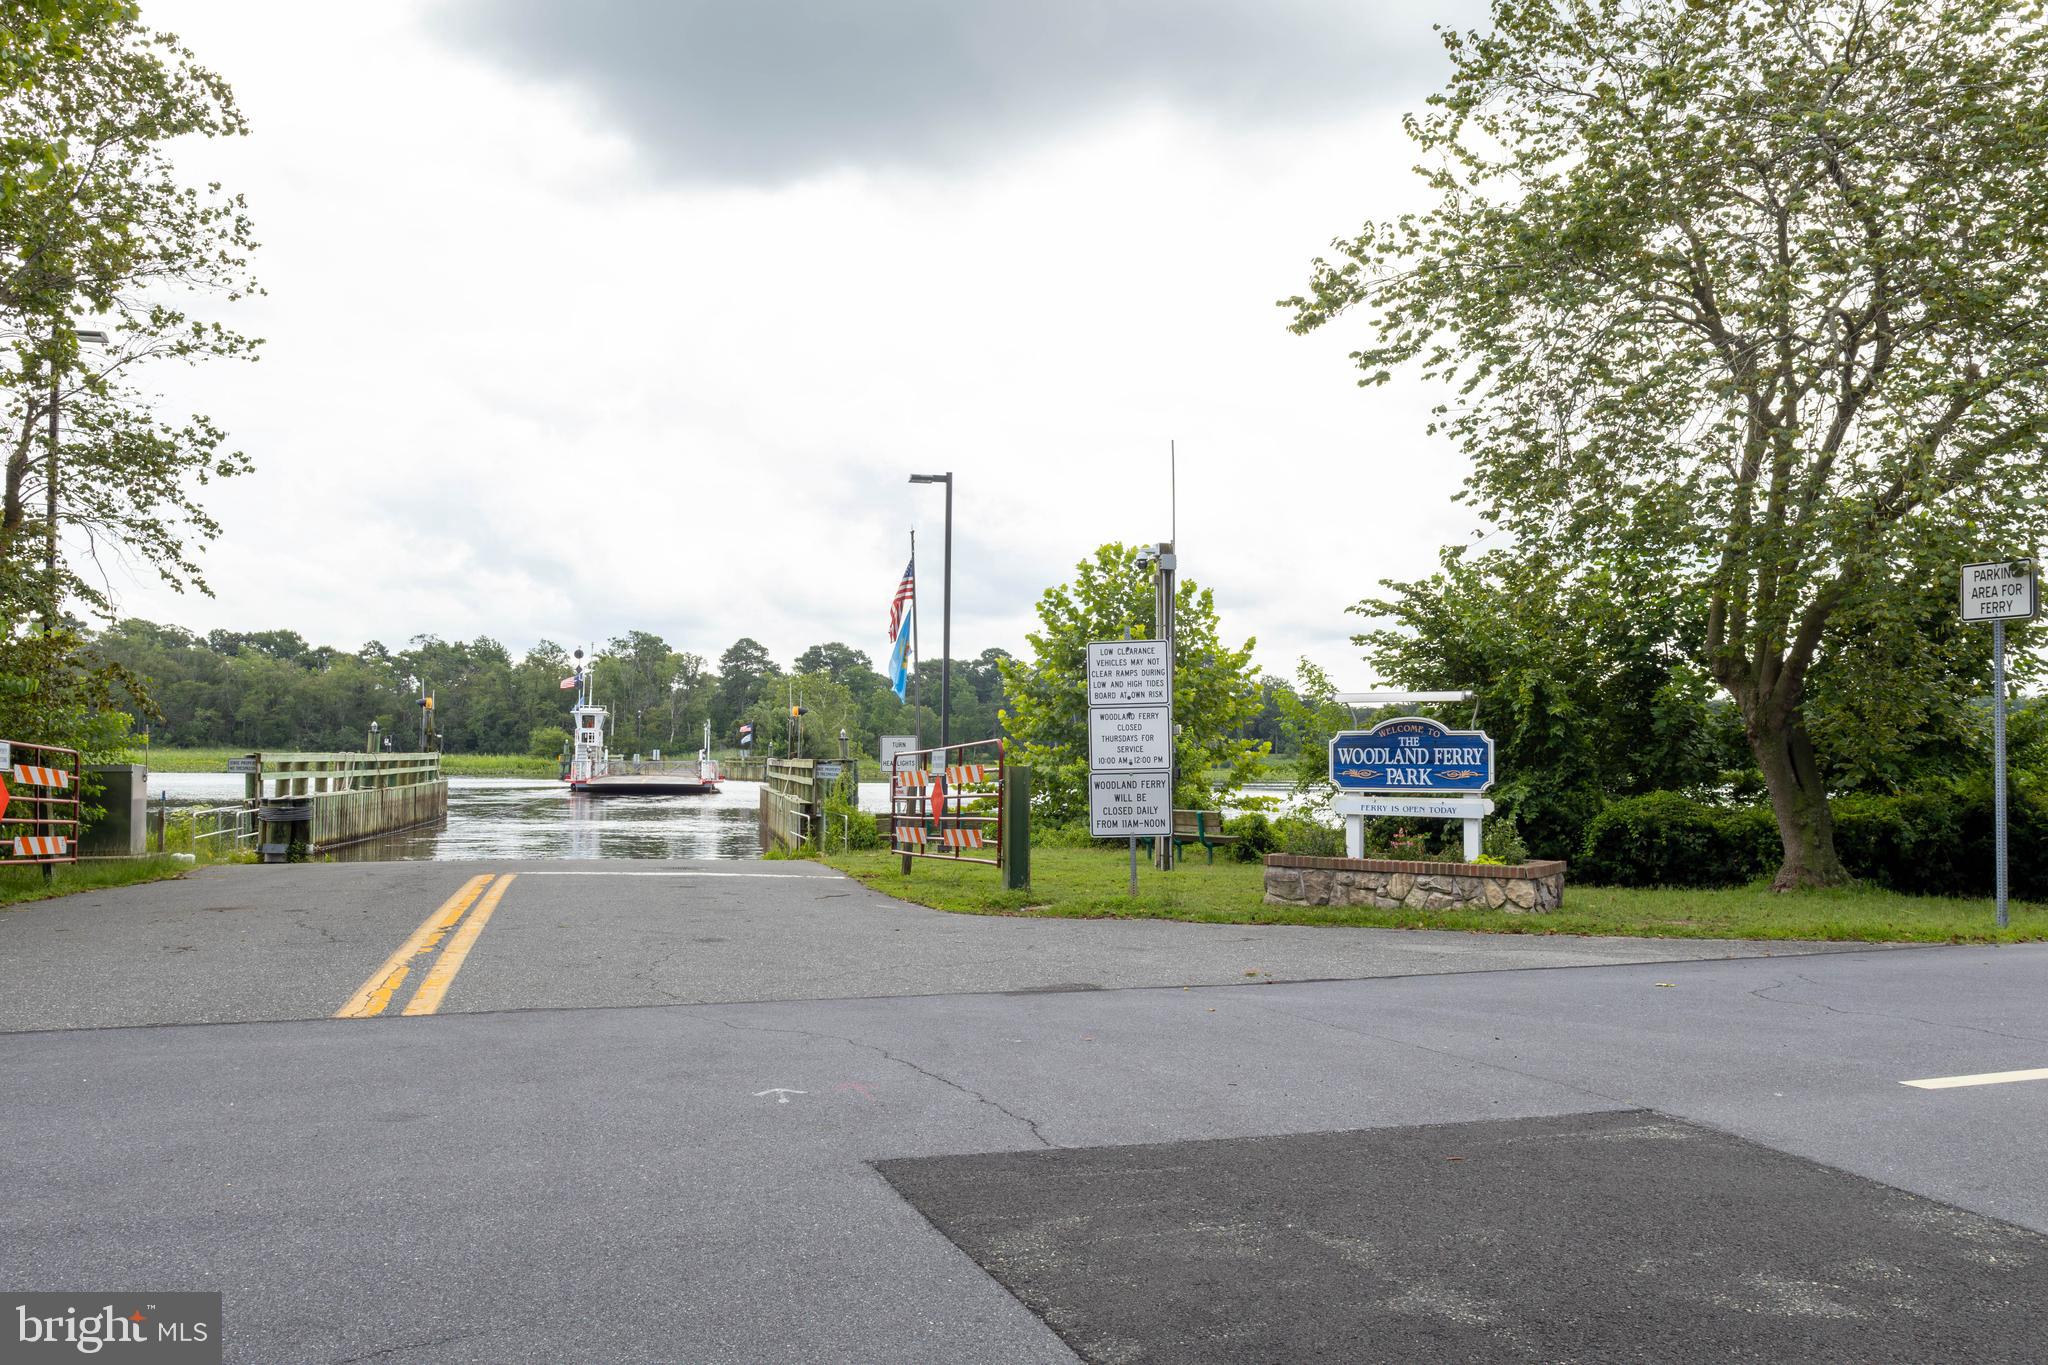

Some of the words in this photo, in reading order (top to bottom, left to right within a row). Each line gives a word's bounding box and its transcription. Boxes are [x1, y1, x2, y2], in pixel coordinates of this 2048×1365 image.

[1974, 567, 2017, 582] PARKIN
[1971, 585, 1999, 600] AREA
[2001, 583, 2023, 597] FOR
[1980, 600, 2013, 615] FERRY
[1100, 648, 1114, 656] LOW
[1096, 659, 1127, 667] VEHICLES
[1130, 658, 1144, 666] MAY
[1147, 657, 1160, 665] NOT
[1091, 670, 1113, 678] CLEAR
[1115, 669, 1138, 677] RAMPS
[1141, 668, 1166, 677] DURING
[1110, 680, 1124, 688] AND
[1127, 680, 1143, 688] HIGH
[1146, 679, 1165, 687] TIDES
[1094, 692, 1117, 700] BOARD
[1120, 691, 1128, 699] AT
[1130, 691, 1146, 699] OWN
[1148, 690, 1164, 698] RISK
[1138, 712, 1160, 720] FERRY
[1117, 723, 1143, 732] CLOSED
[1378, 725, 1424, 738] WELCOME
[1428, 727, 1441, 738] TO
[1101, 734, 1138, 743] THURSDAYS
[1141, 734, 1155, 742] FOR
[1398, 736, 1420, 747] THE
[1117, 745, 1144, 753] SERVICE
[1098, 757, 1116, 765] 10:00
[1118, 756, 1128, 764] AM
[1133, 756, 1152, 764] 12:00
[1153, 755, 1163, 764] PM
[1337, 747, 1429, 765] WOODLAND
[1434, 747, 1484, 765] FERRY
[1385, 768, 1433, 786] PARK
[1094, 780, 1138, 790] WOODLAND
[1141, 780, 1166, 789] FERRY
[1114, 793, 1133, 803] WILL
[1136, 793, 1147, 802] BE
[1102, 806, 1133, 816] CLOSED
[1136, 806, 1159, 815] DAILY
[1360, 804, 1388, 813] FERRY
[1391, 805, 1400, 813] IS
[1402, 805, 1426, 814] OPEN
[1429, 806, 1457, 815] TODAY
[1096, 820, 1118, 829] FROM
[1121, 819, 1166, 829] 11AM-NOON
